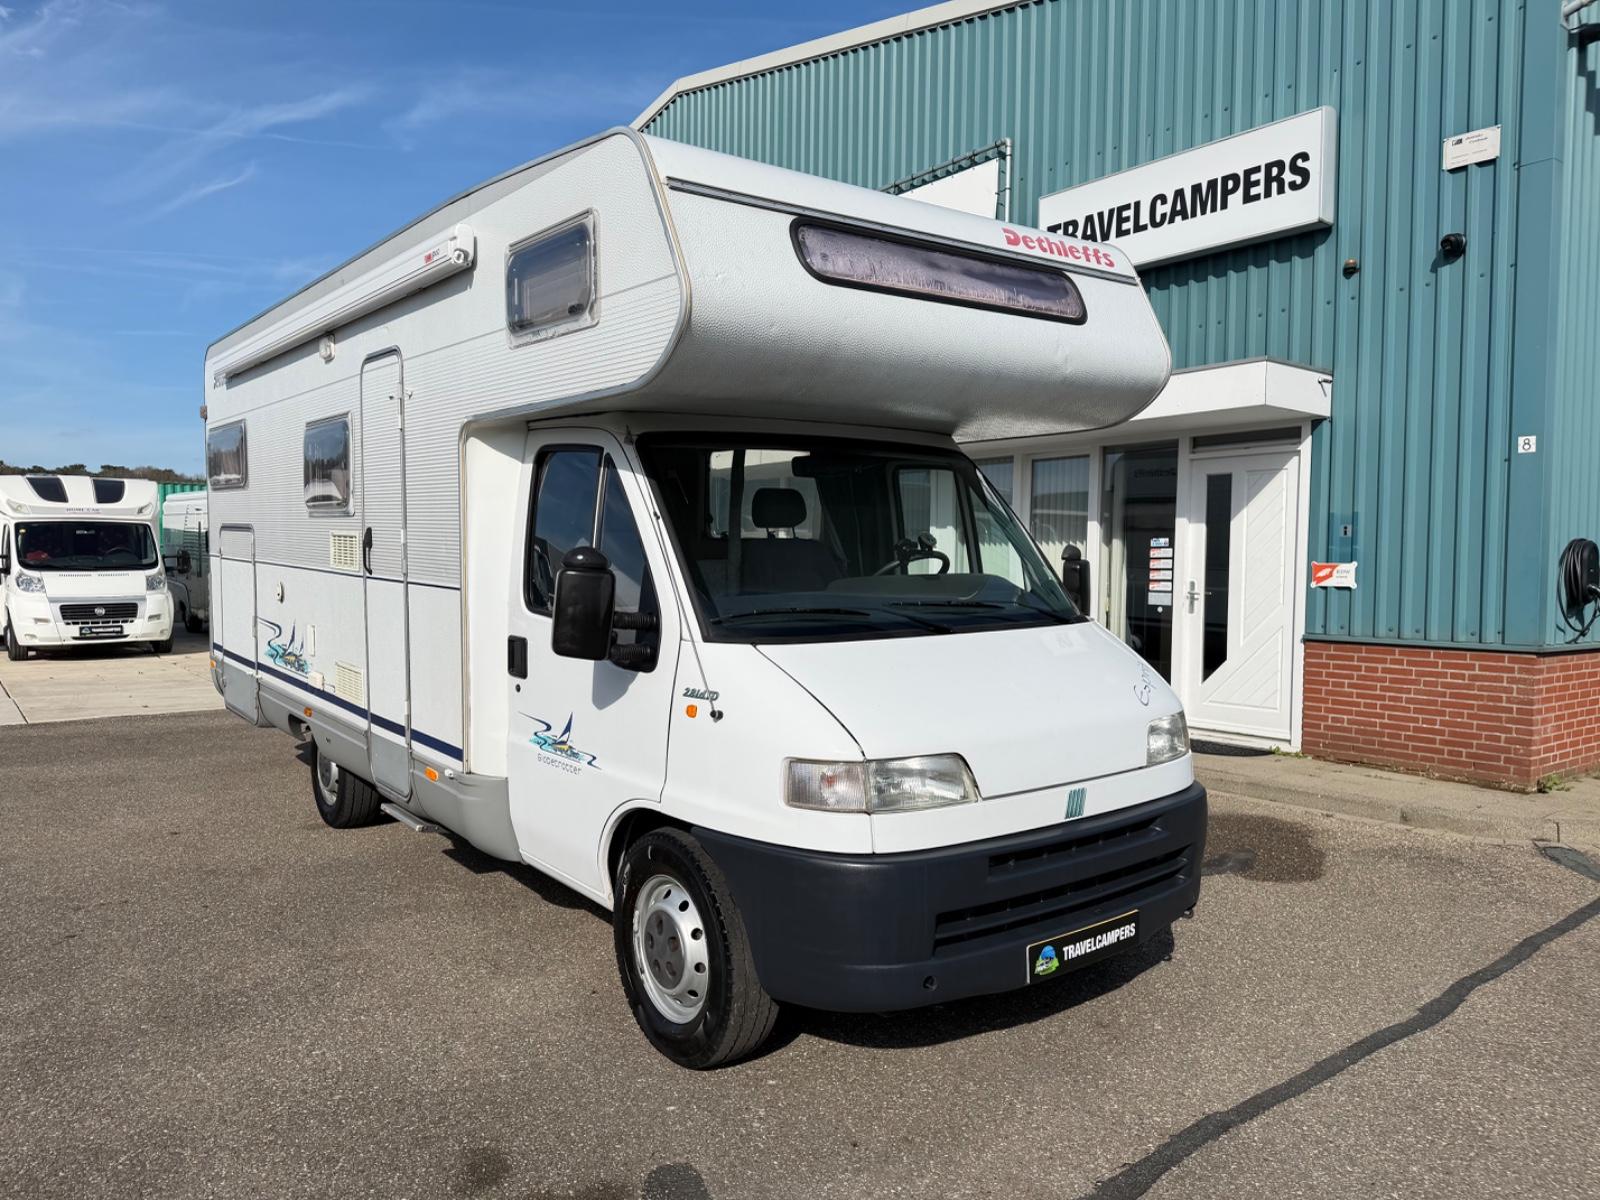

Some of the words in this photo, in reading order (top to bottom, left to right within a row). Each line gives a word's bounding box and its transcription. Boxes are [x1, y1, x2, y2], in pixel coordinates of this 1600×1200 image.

[1002, 227, 1115, 268] Dethleffs
[1522, 437, 1531, 451] 8
[1062, 922, 1136, 961] TRAVELCAMPERS
